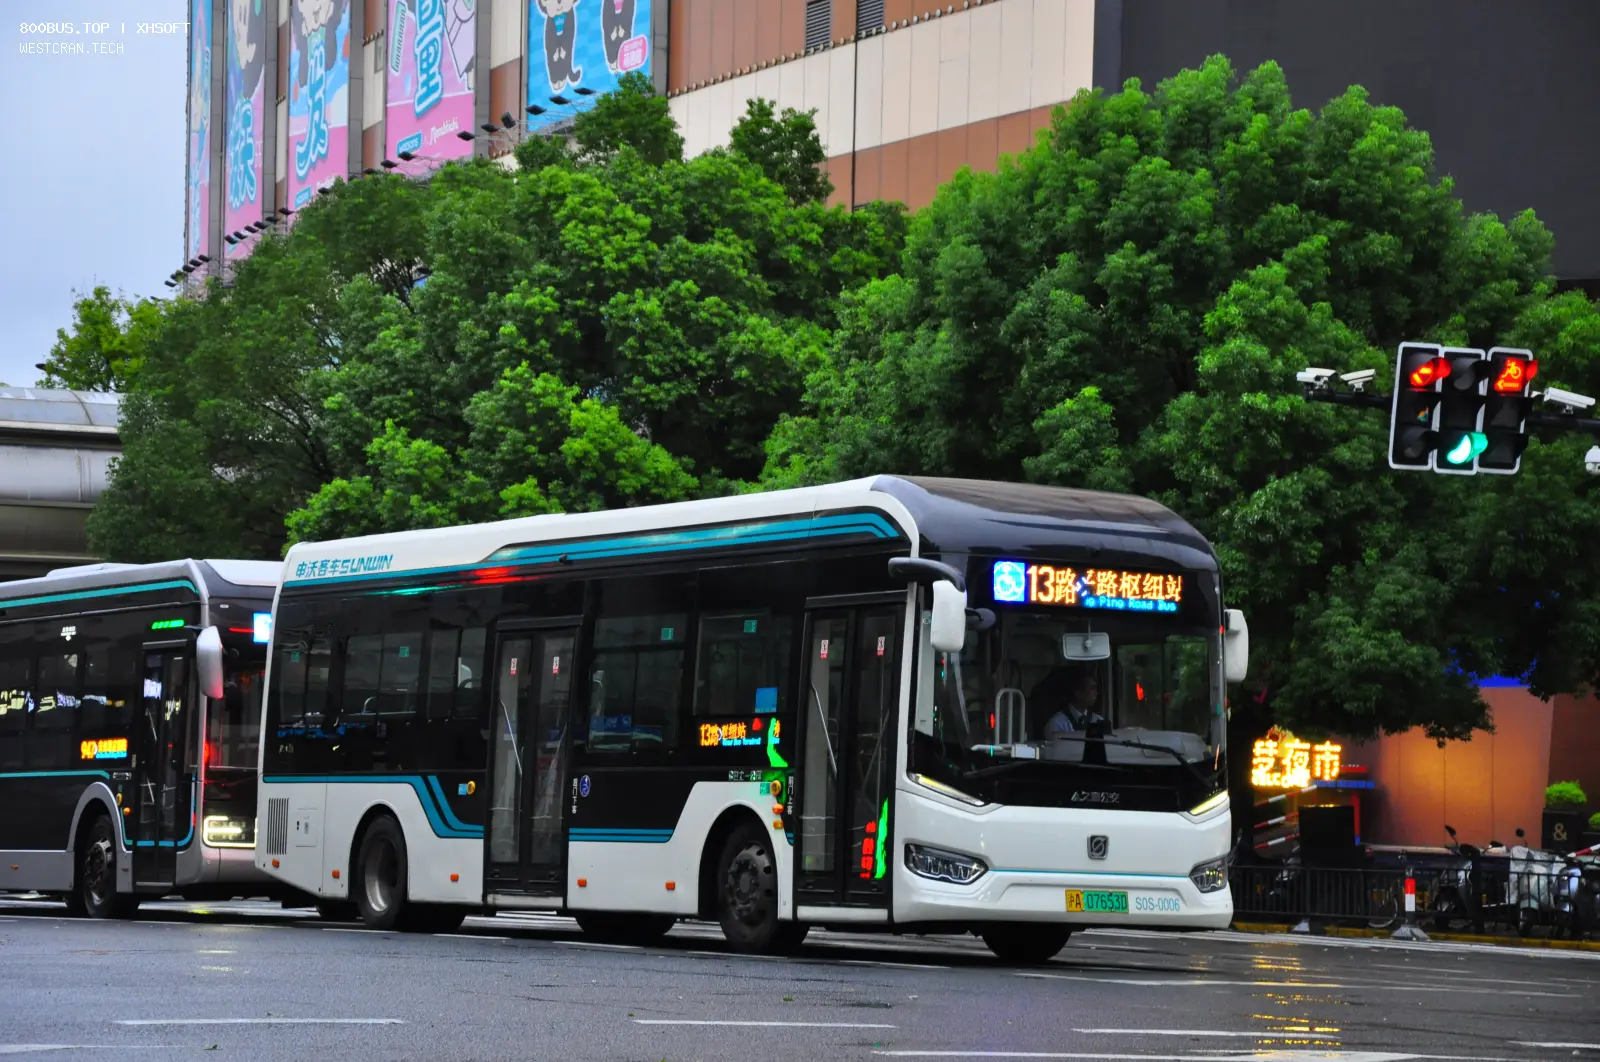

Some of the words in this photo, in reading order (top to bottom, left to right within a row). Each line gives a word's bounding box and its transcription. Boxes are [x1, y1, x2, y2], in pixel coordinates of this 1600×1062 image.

[296, 559, 339, 578] 申沃客车
[339, 554, 394, 574] SUNWIN
[1026, 565, 1077, 604] 13路
[1099, 597, 1125, 609] Ping
[1128, 598, 1153, 610] Road
[1157, 600, 1177, 612] Bus
[1553, 822, 1568, 841] &
[1067, 893, 1082, 909] 沪A
